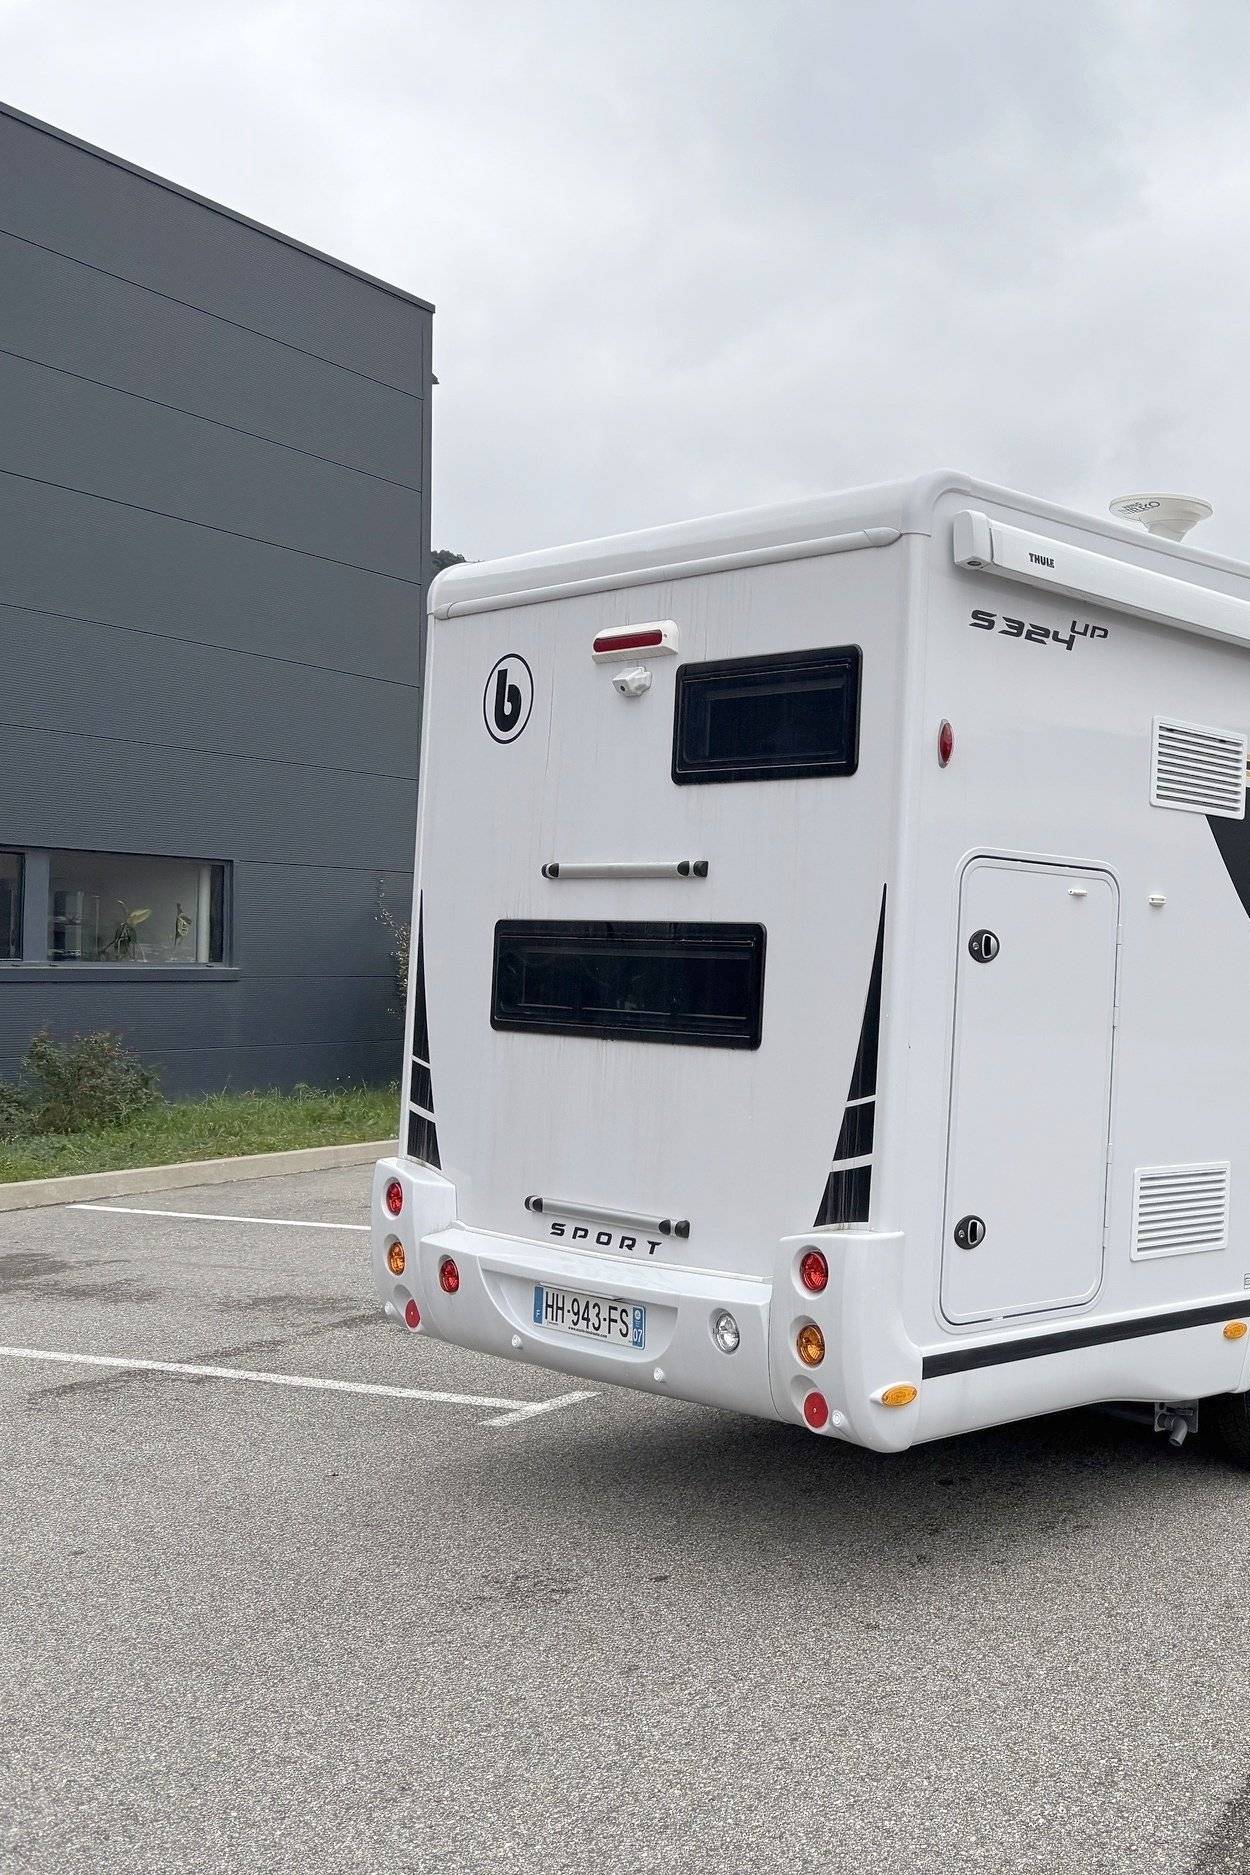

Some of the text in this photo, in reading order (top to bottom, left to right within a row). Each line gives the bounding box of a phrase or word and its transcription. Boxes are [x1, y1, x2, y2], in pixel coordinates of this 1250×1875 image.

[1029, 552, 1055, 569] THULE
[550, 1222, 662, 1255] SPORT
[545, 1291, 629, 1338] HH-943-FS
[633, 1328, 642, 1343] 07
